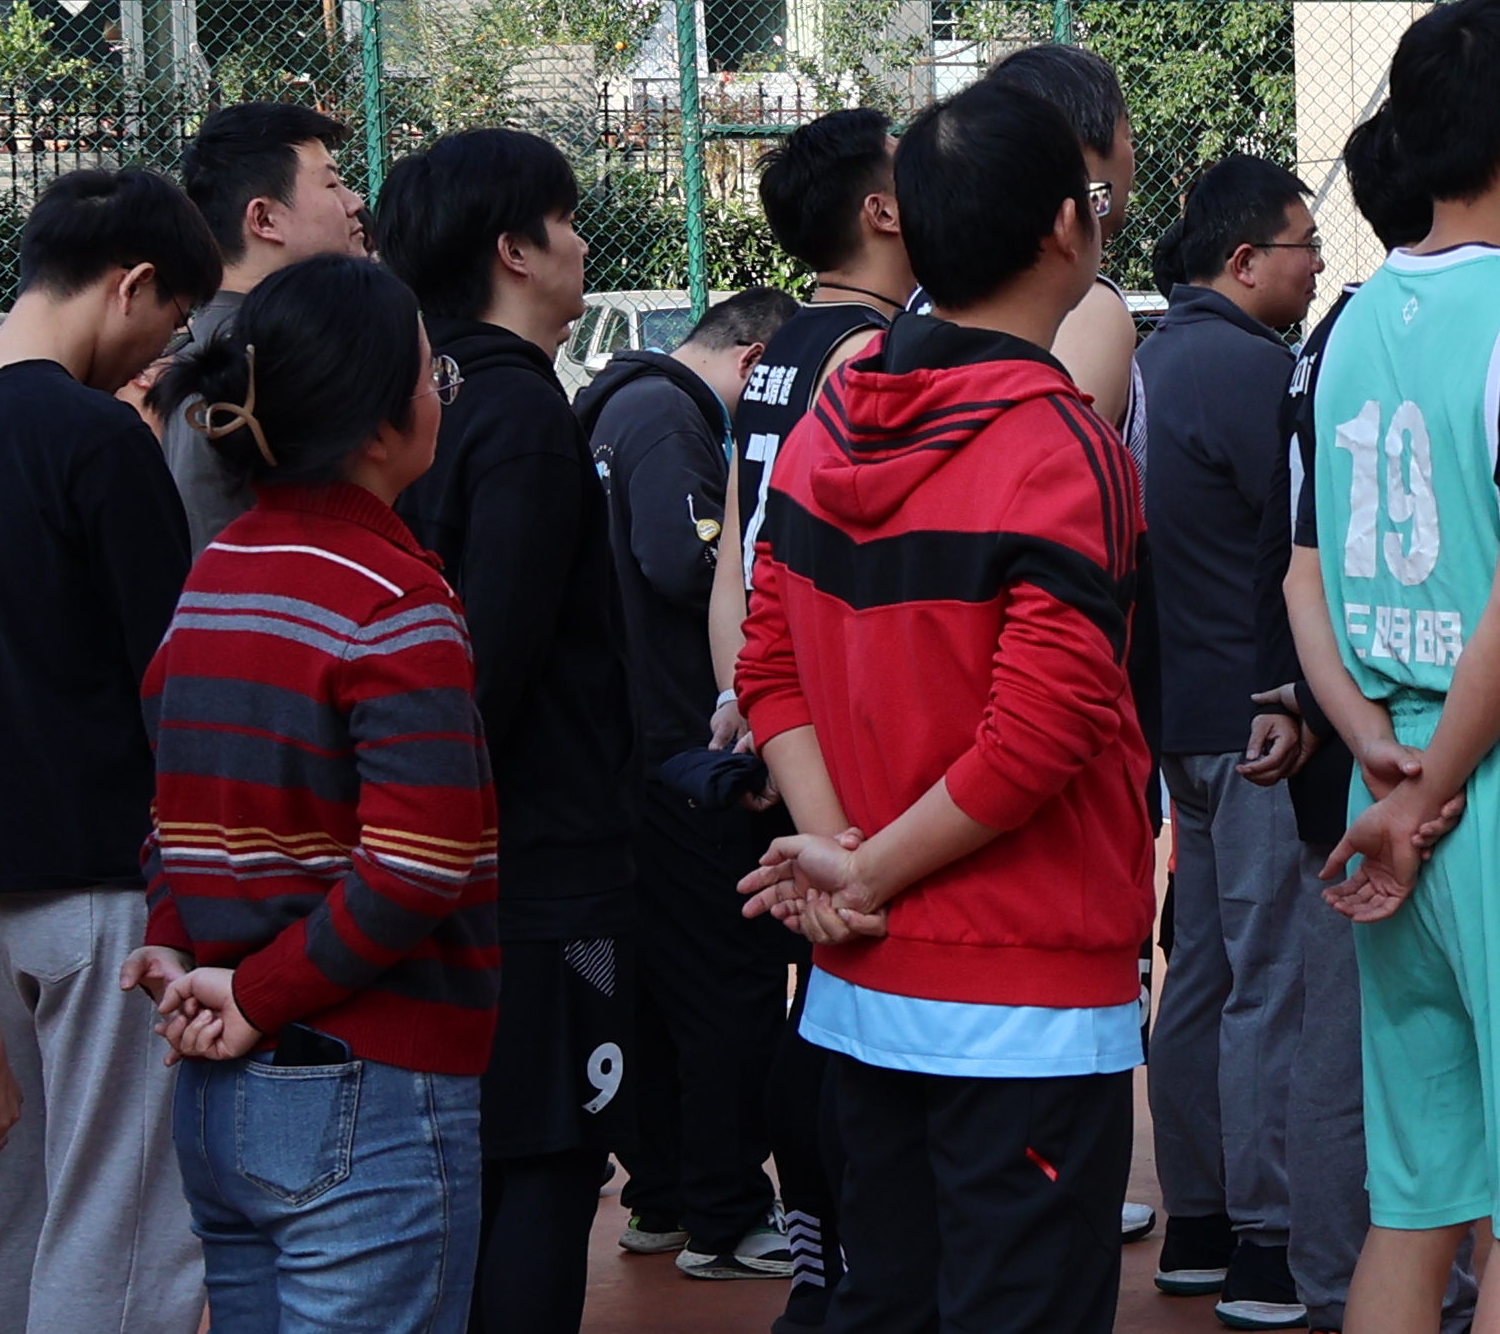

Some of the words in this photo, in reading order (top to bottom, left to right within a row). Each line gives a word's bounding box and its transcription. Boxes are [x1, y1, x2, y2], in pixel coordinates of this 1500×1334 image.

[743, 433, 780, 590] 7
[1335, 399, 1441, 587] 19
[581, 1041, 624, 1115] 9
